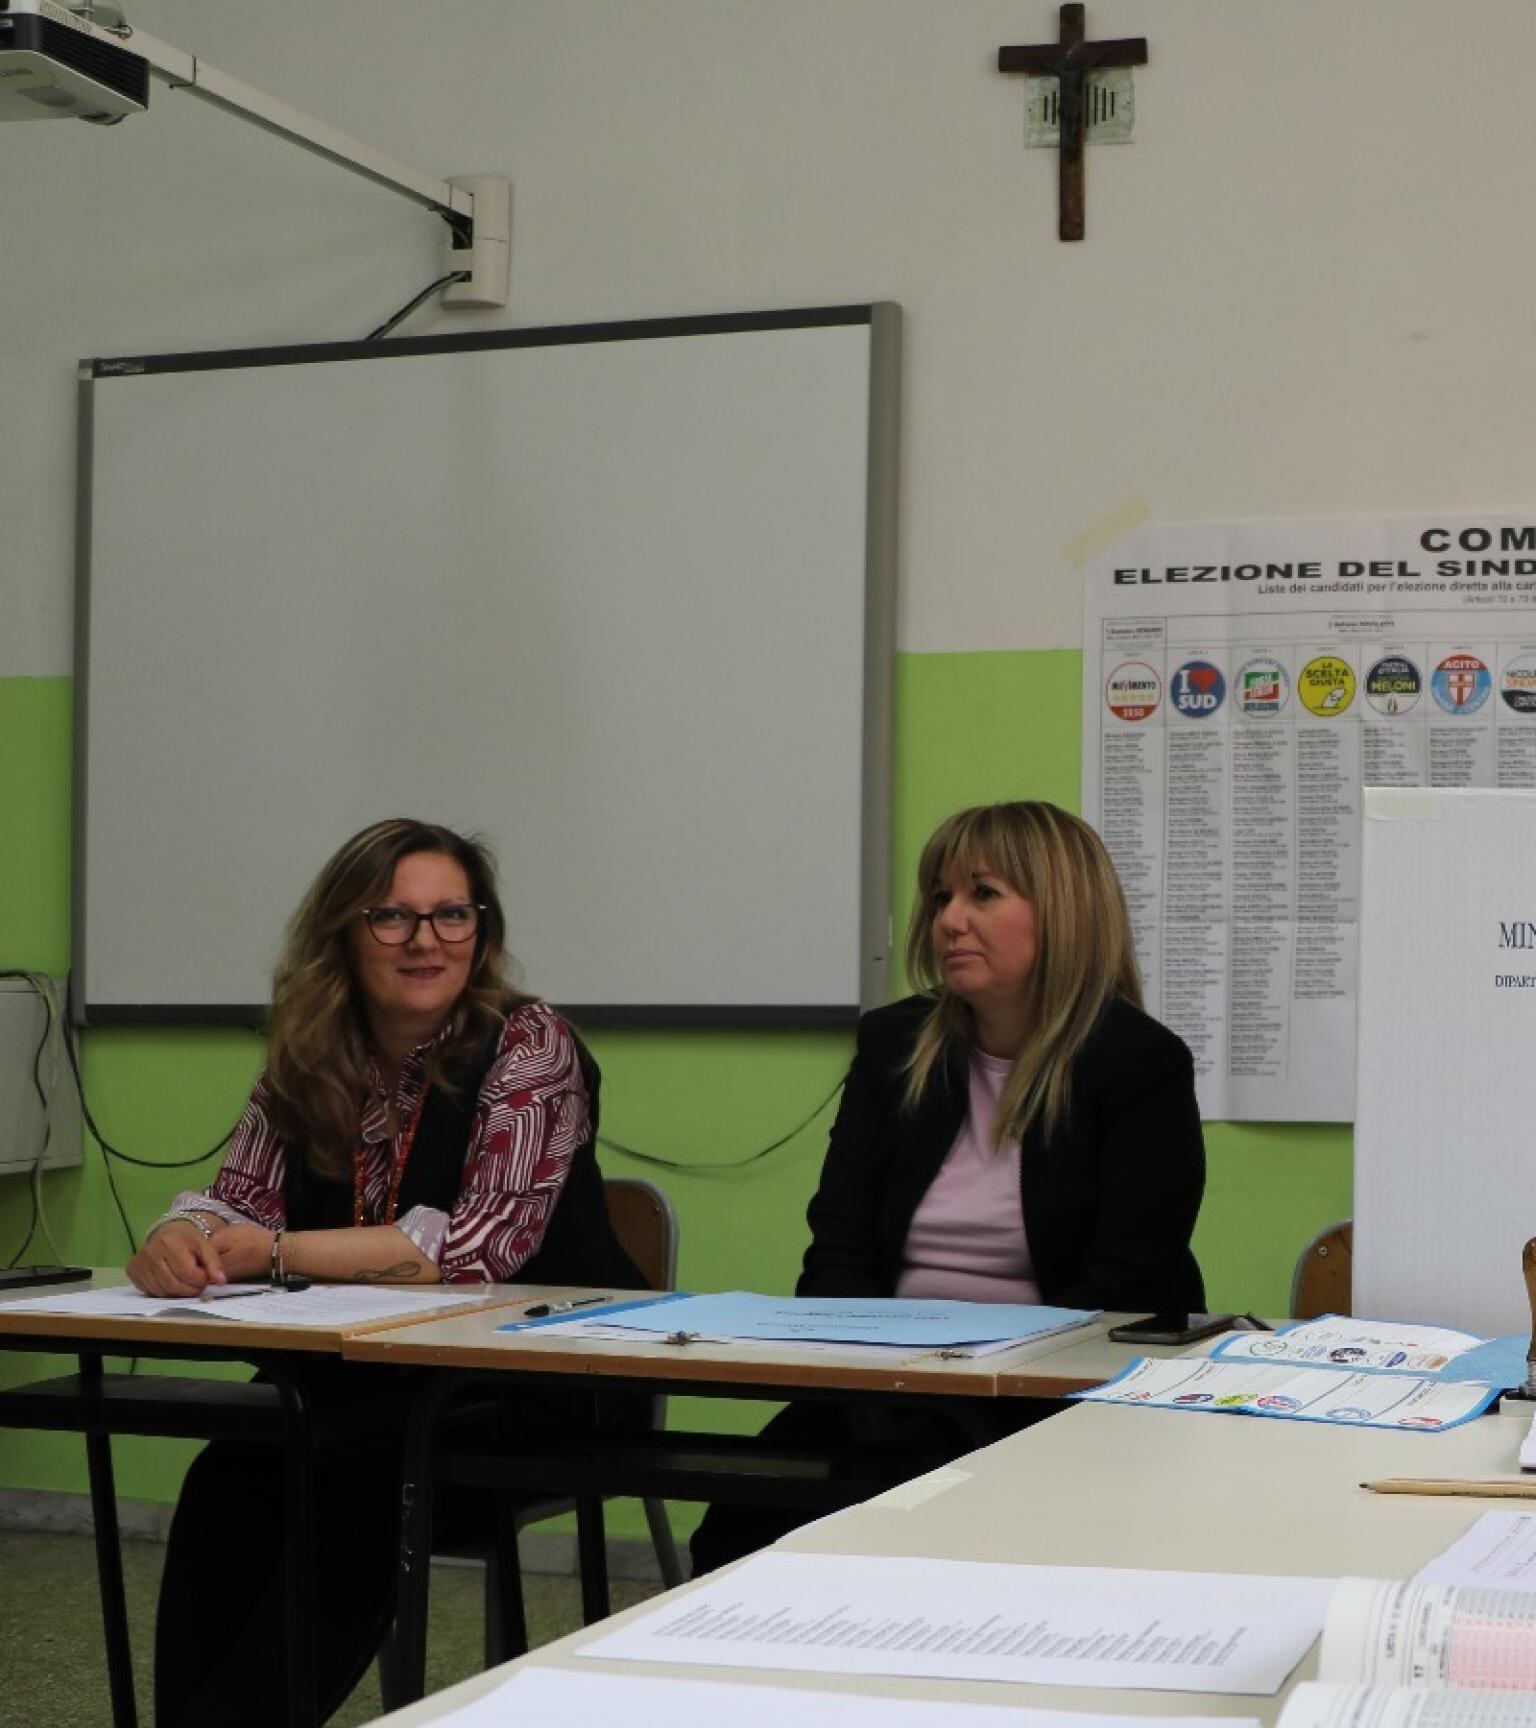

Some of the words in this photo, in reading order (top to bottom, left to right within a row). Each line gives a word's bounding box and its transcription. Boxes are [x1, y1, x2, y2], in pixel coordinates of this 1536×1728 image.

[1114, 562, 1322, 585] ELEZIONE
[1338, 560, 1421, 577] DEL
[1257, 583, 1286, 594] Liste
[1289, 583, 1306, 593] dei
[1310, 582, 1364, 593] candidati
[1367, 582, 1386, 594] per
[1390, 581, 1447, 592] l'elezione
[1449, 580, 1489, 592] diretta
[1491, 580, 1512, 591] alla
[1444, 660, 1480, 669] ACITO
[1179, 669, 1193, 695] I
[1372, 681, 1416, 691] MELONI
[1178, 694, 1218, 709] SUD
